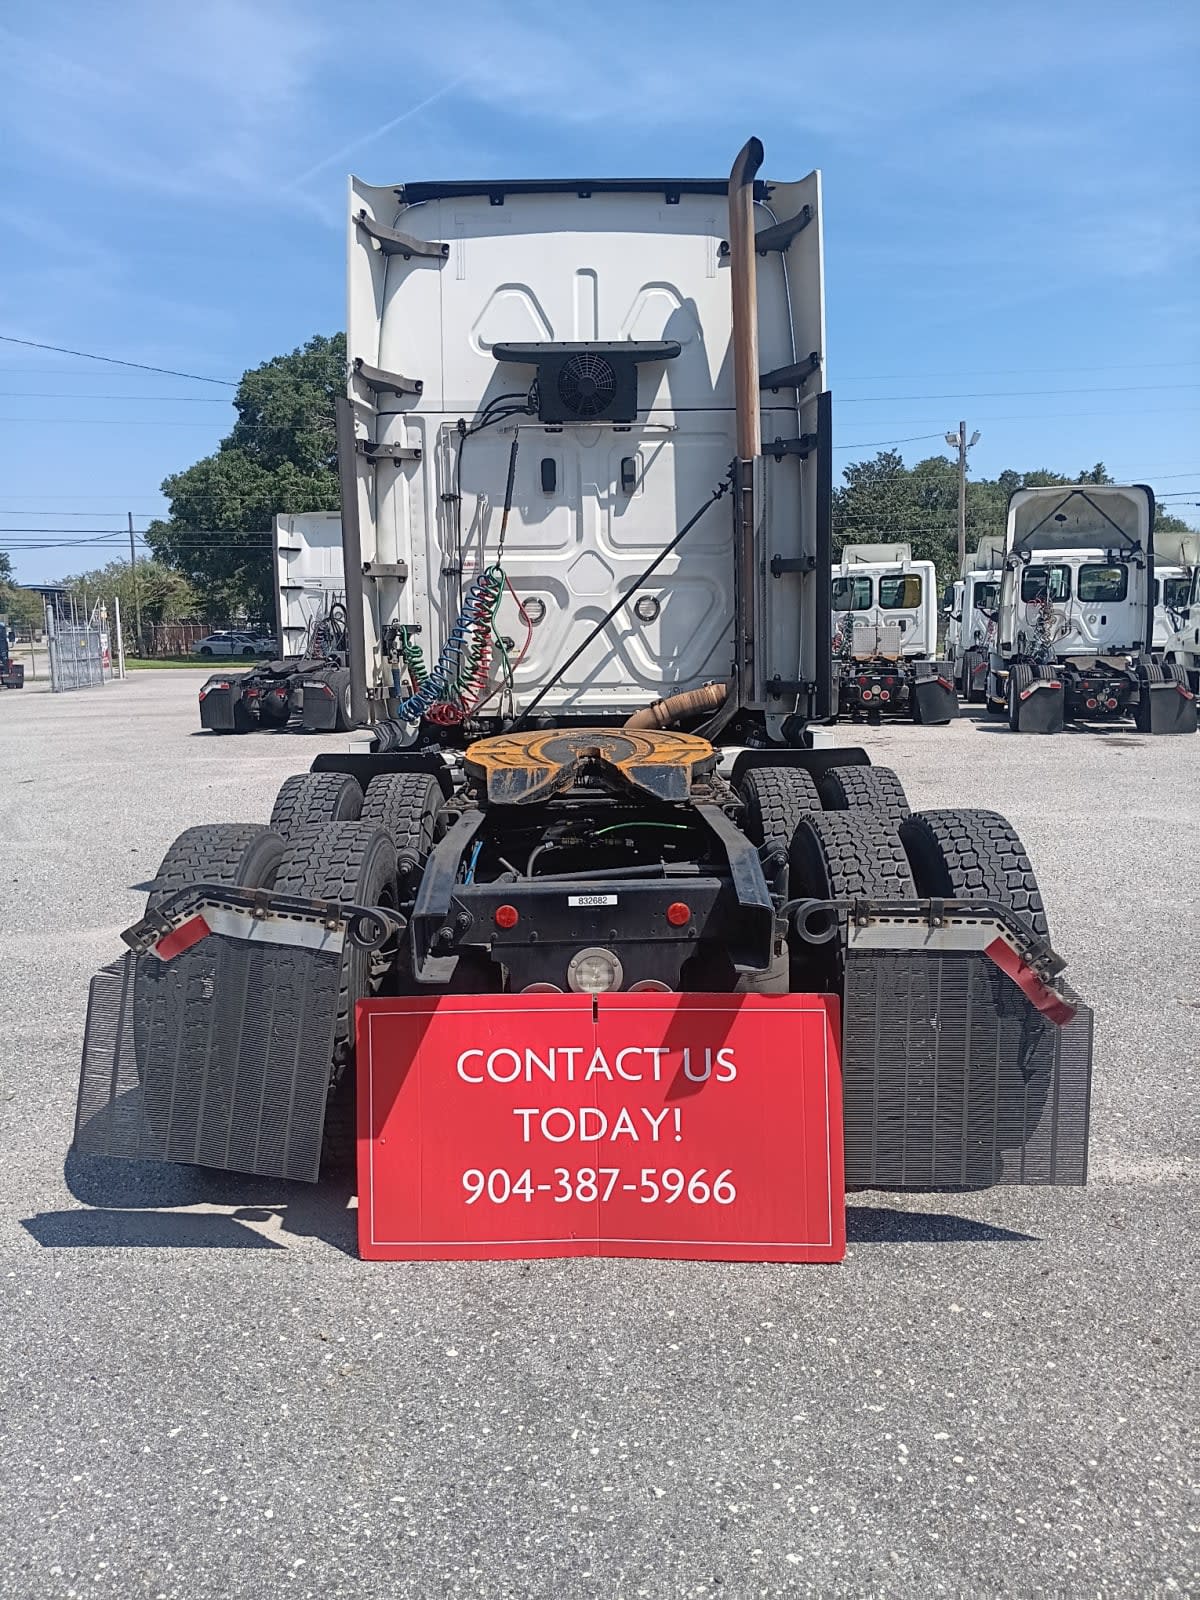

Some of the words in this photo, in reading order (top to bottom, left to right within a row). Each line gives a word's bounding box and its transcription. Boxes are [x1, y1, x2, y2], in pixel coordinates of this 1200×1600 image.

[578, 896, 608, 905] 832682
[456, 1046, 670, 1083] CONTACT
[683, 1047, 738, 1083] US
[513, 1107, 684, 1143] TODAY!
[462, 1167, 737, 1205] 904-387-5966
